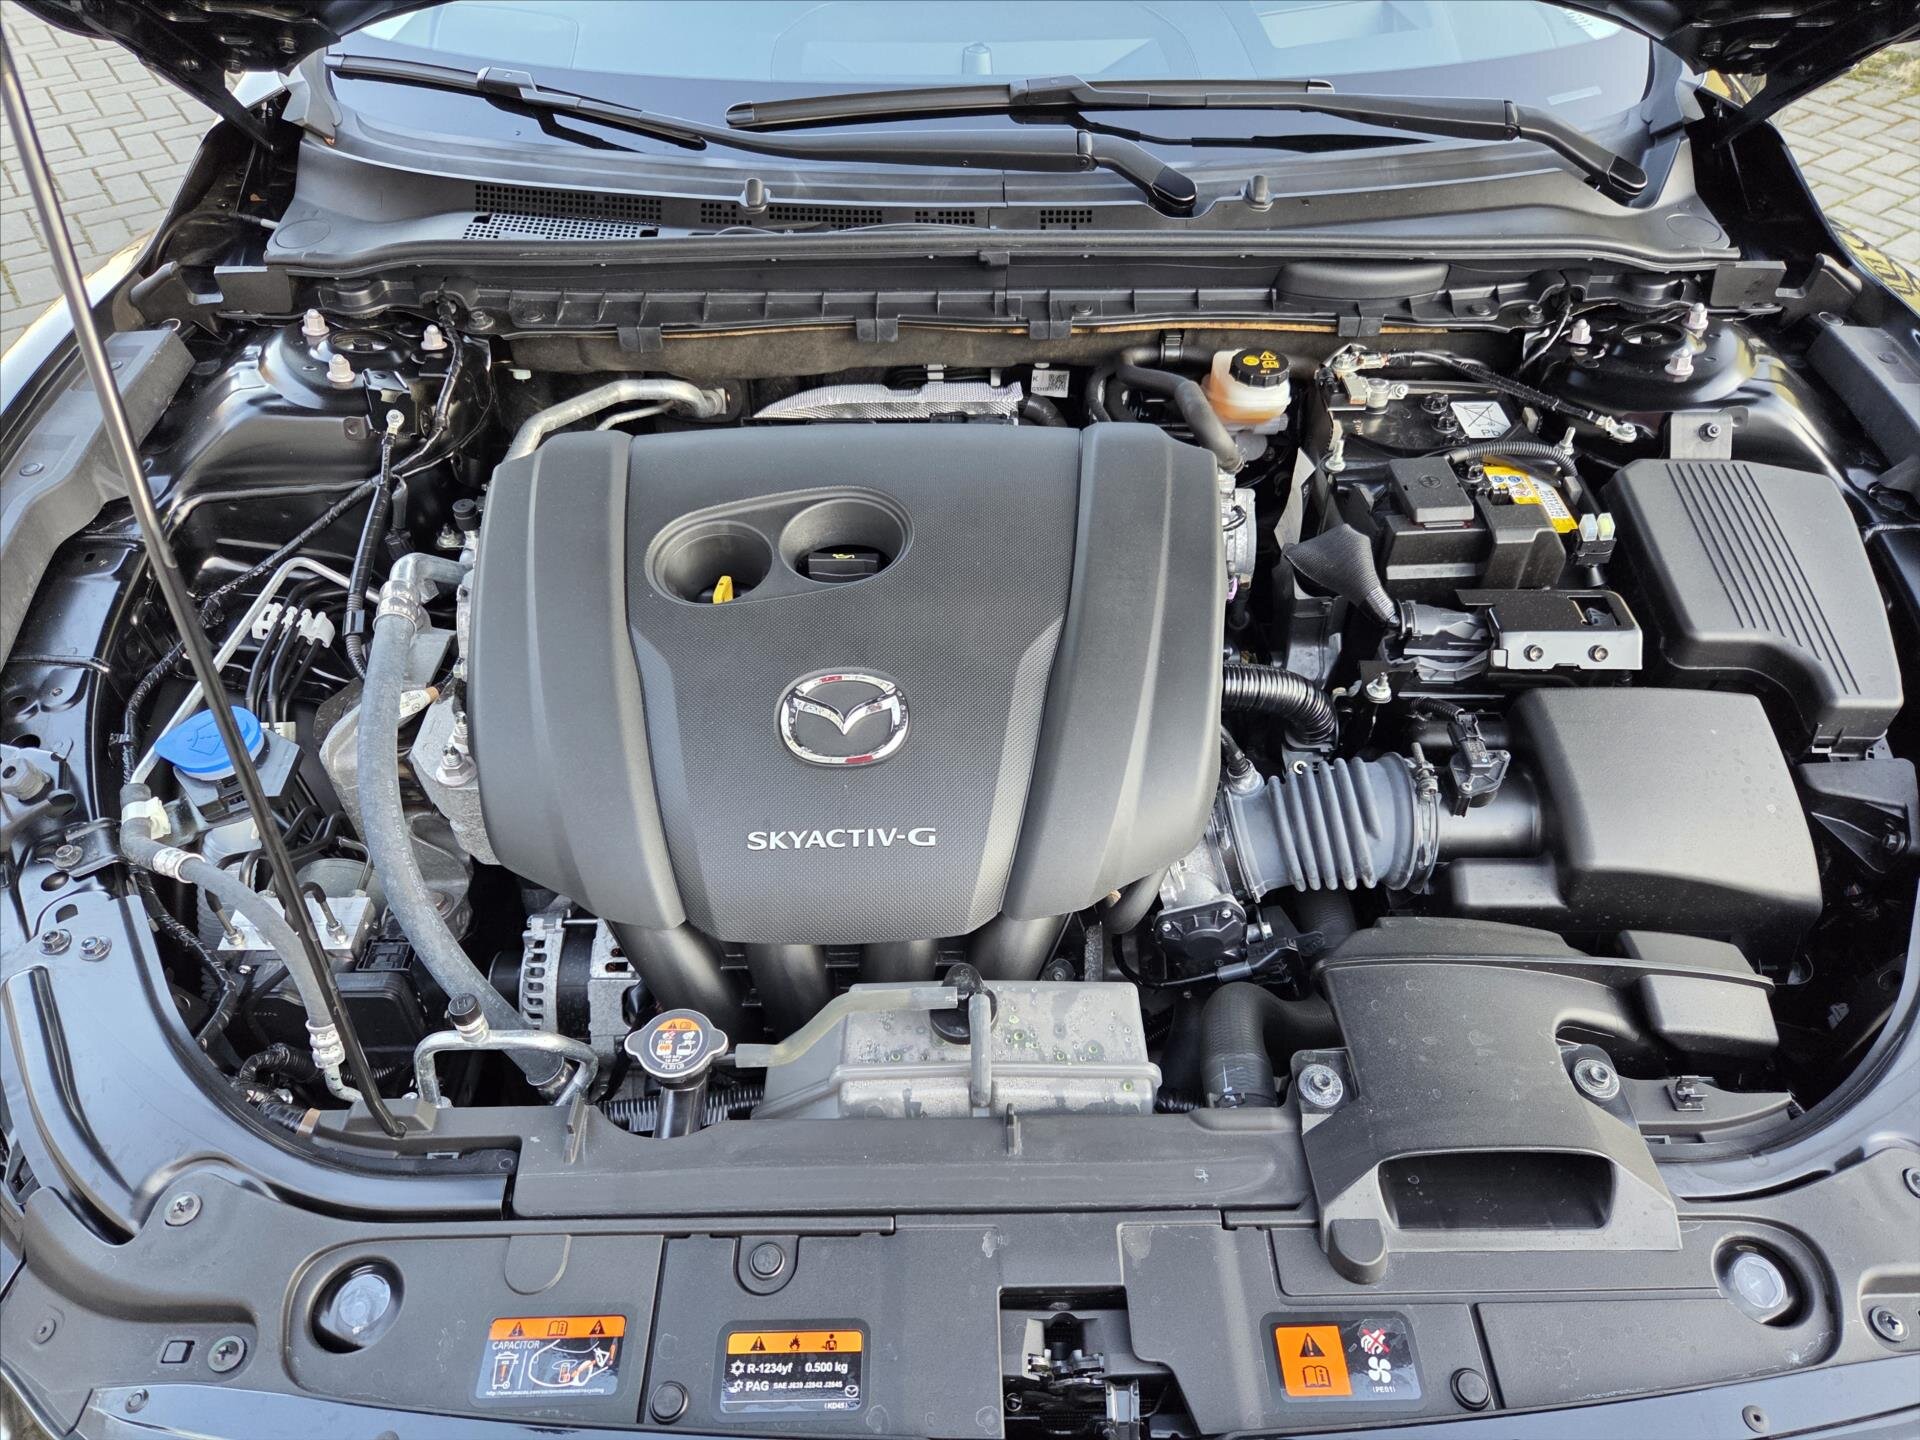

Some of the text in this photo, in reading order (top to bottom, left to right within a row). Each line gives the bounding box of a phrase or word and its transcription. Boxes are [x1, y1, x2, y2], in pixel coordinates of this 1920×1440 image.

[1481, 429, 1501, 437] Pb
[747, 827, 937, 850] SKYACTIV-G
[491, 1340, 541, 1351] CAPACITOR
[746, 1361, 848, 1375] R-1234yf 0.500 kg
[745, 1380, 770, 1392] PAG
[773, 1381, 788, 1389] SAE
